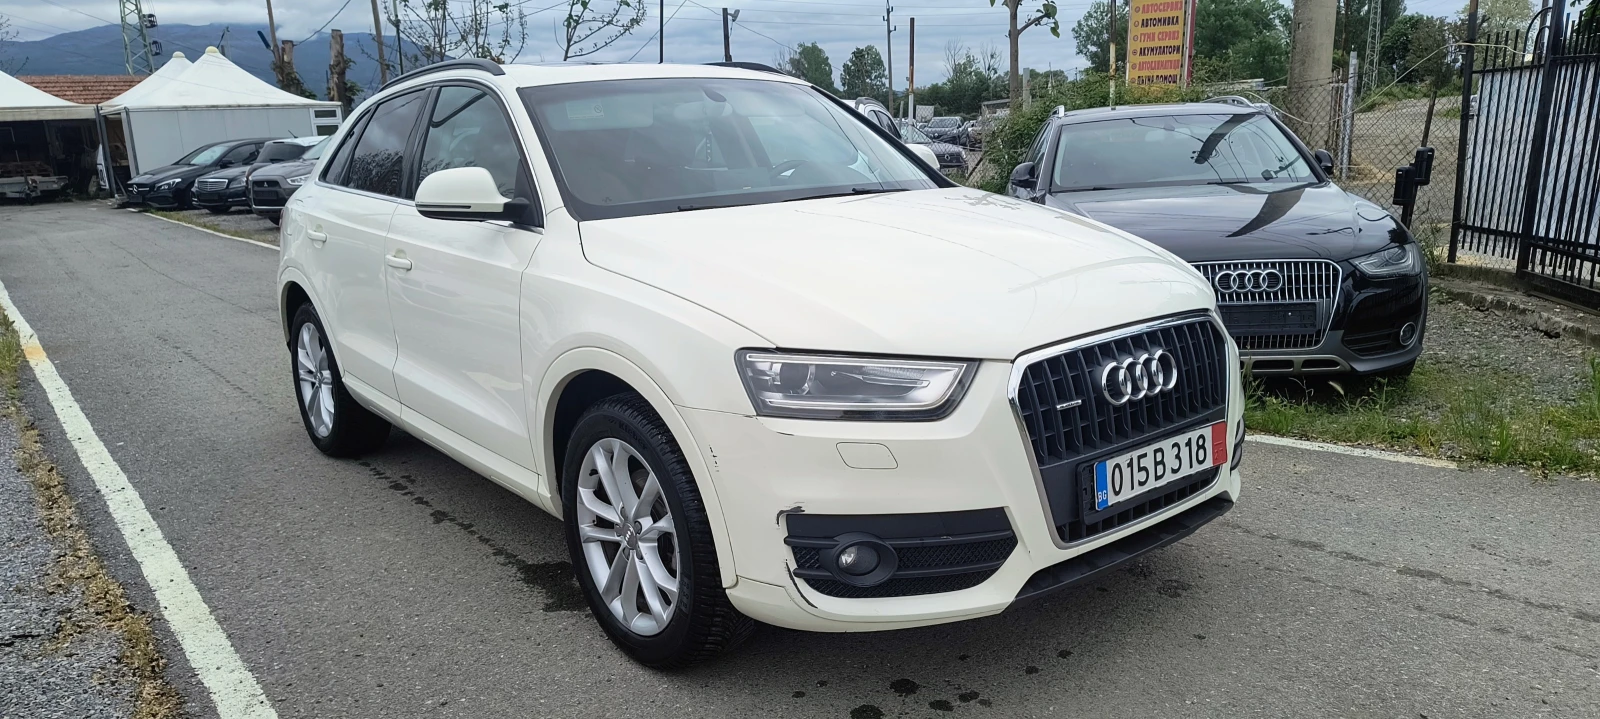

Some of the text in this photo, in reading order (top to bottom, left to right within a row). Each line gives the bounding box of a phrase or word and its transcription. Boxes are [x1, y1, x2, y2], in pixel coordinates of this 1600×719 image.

[1141, 1, 1183, 14] АВТОСЕРВИЗ
[1141, 16, 1179, 28] АВТОМИВКА
[1140, 30, 1180, 42] ГУМИ СЕРВИЗ
[1139, 45, 1180, 57] АКУМУЛАТОРИ
[1111, 433, 1207, 497] 015B318
[1097, 489, 1107, 502] BG
